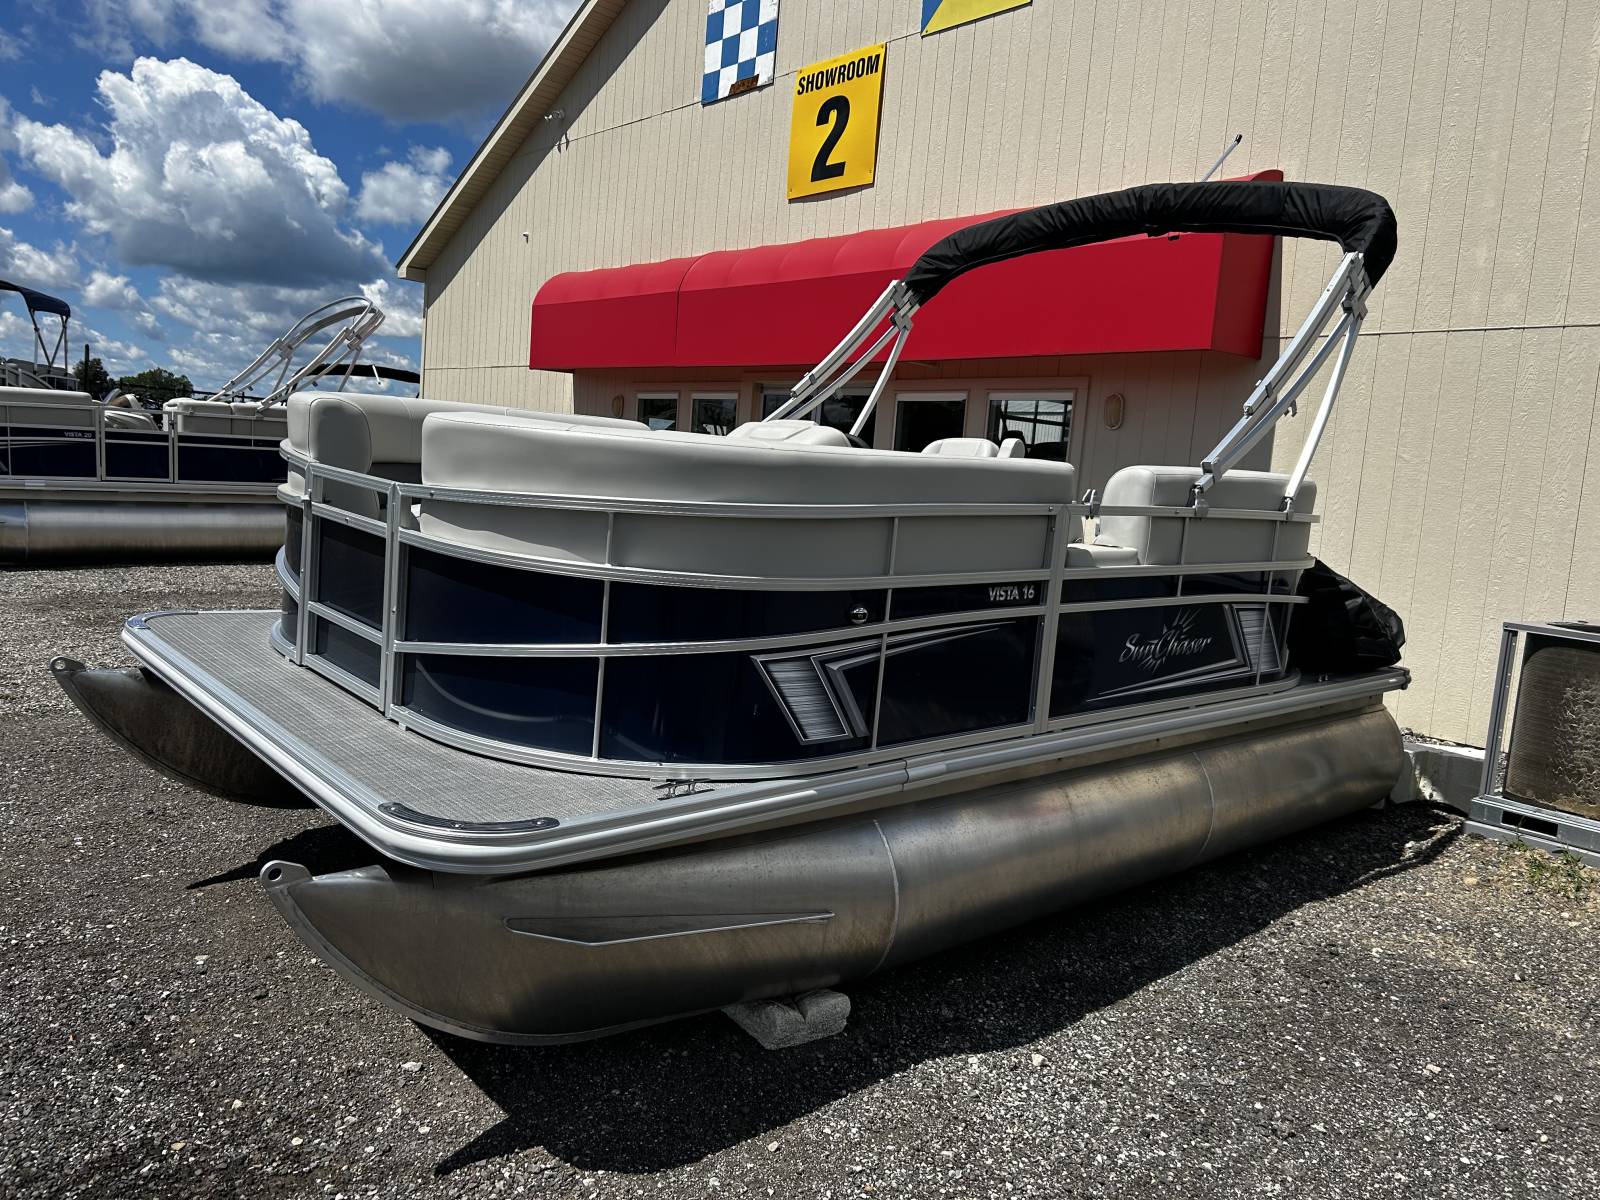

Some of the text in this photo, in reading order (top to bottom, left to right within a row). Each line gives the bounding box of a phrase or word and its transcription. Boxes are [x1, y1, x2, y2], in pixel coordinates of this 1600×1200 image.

[797, 53, 881, 96] SHOWROOM
[810, 95, 851, 183] 2
[988, 584, 1035, 601] VISTA 16
